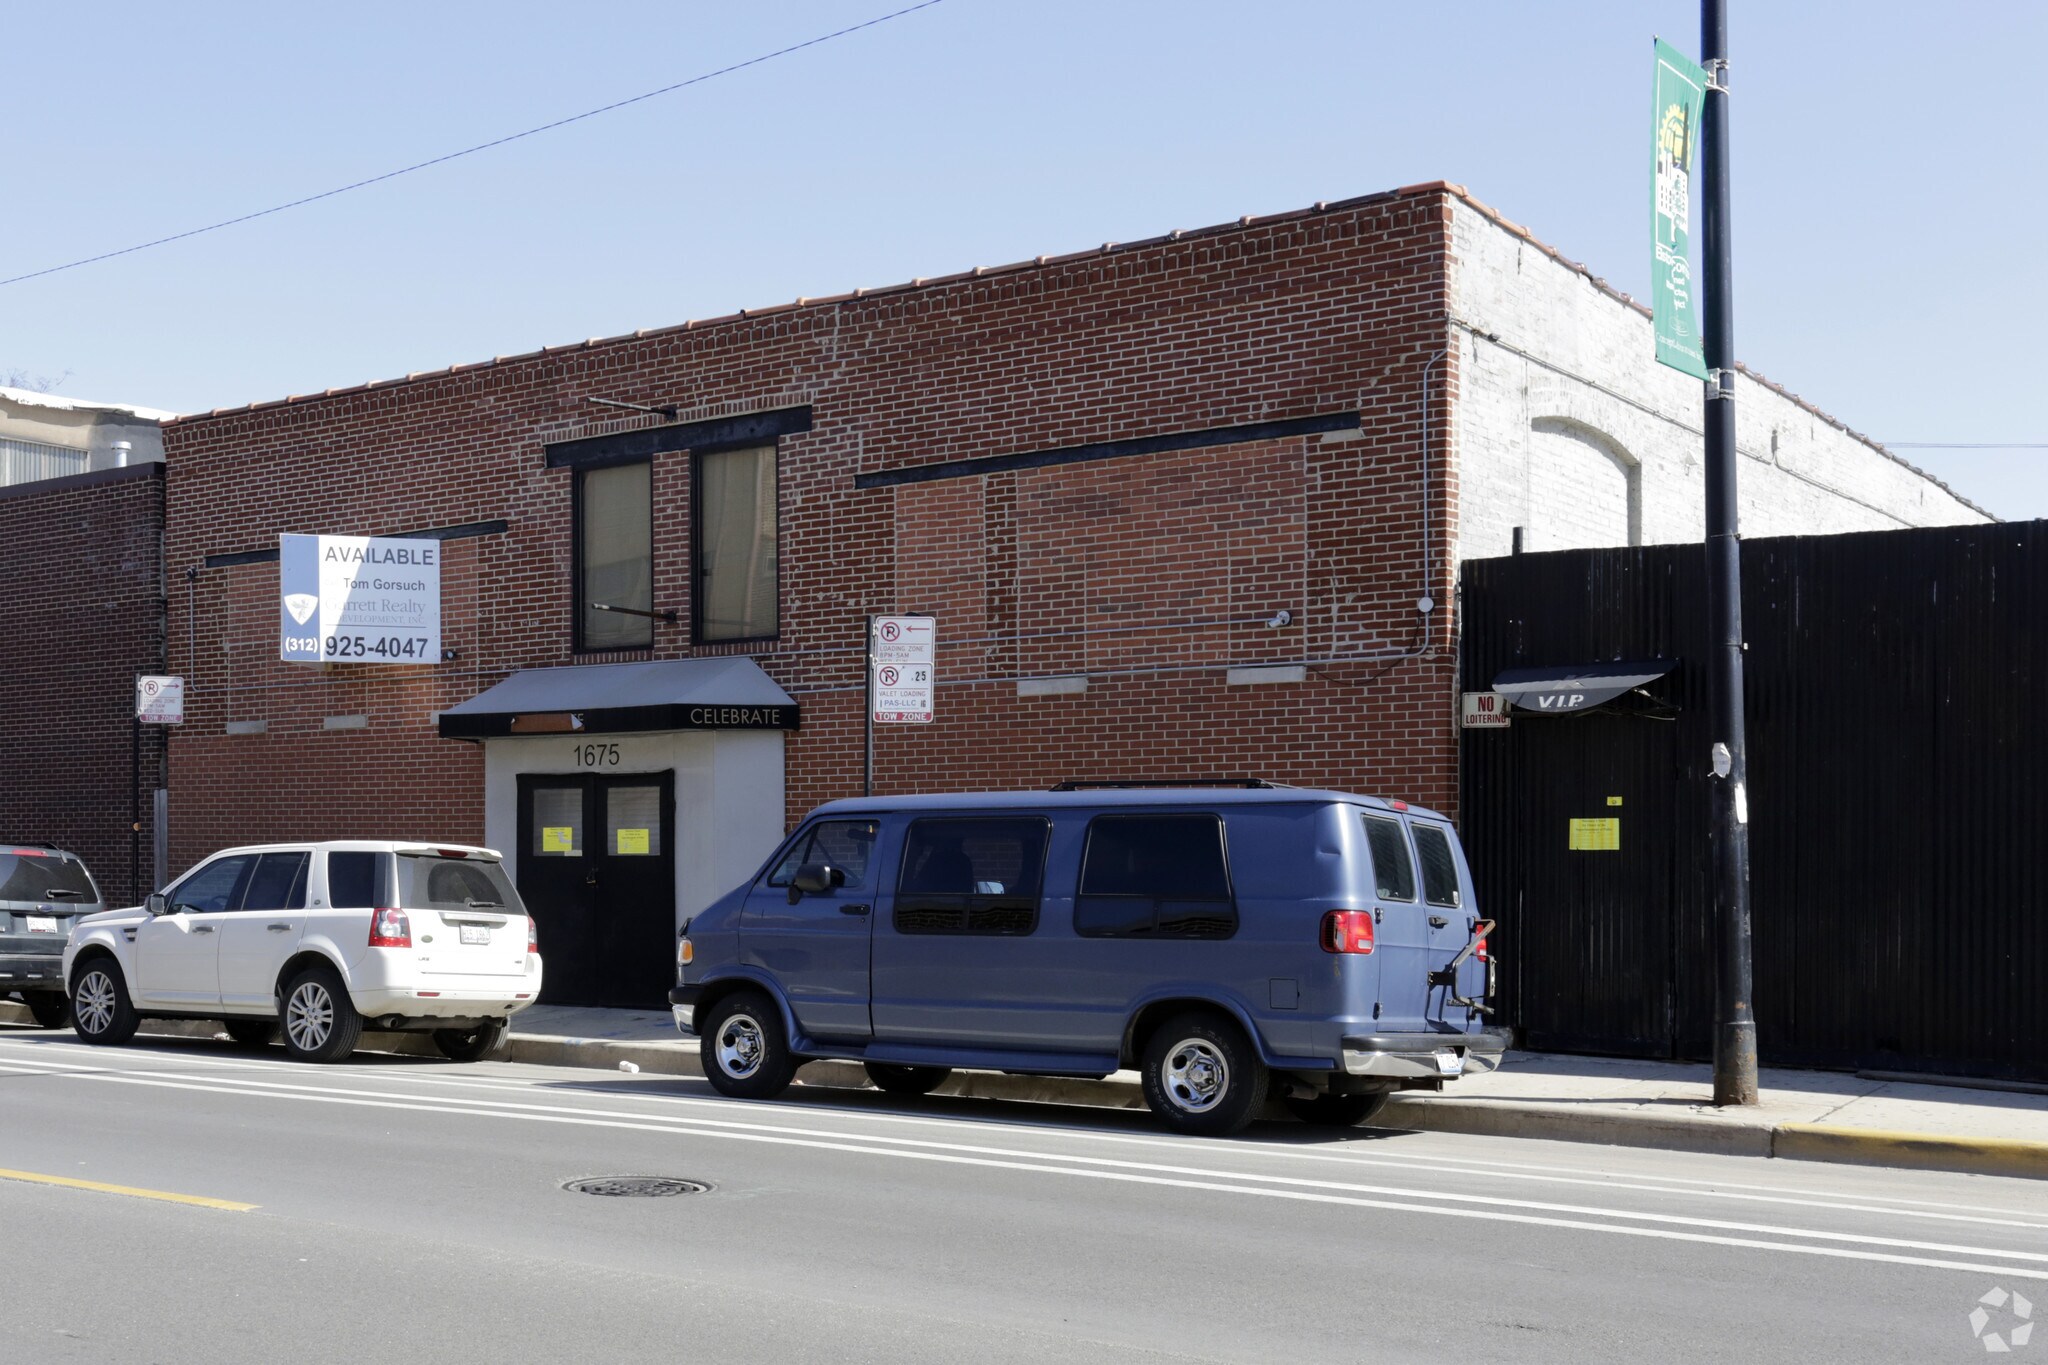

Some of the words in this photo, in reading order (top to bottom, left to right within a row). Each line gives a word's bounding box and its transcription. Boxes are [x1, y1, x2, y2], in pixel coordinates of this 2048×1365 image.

[325, 546, 434, 566] AVAILABLE
[343, 577, 369, 590] Tom
[373, 578, 426, 591] Gorsuch
[381, 598, 426, 616] Realty
[285, 636, 318, 653] (312)
[325, 635, 428, 658] 925-4047
[884, 699, 916, 707] PAS-LLC
[1477, 695, 1494, 712] NO
[690, 708, 780, 724] CELEBRATE
[878, 712, 897, 720] TOW
[902, 712, 927, 720] ZONE
[1465, 713, 1506, 725] LOITERING
[573, 743, 620, 767] 1675
